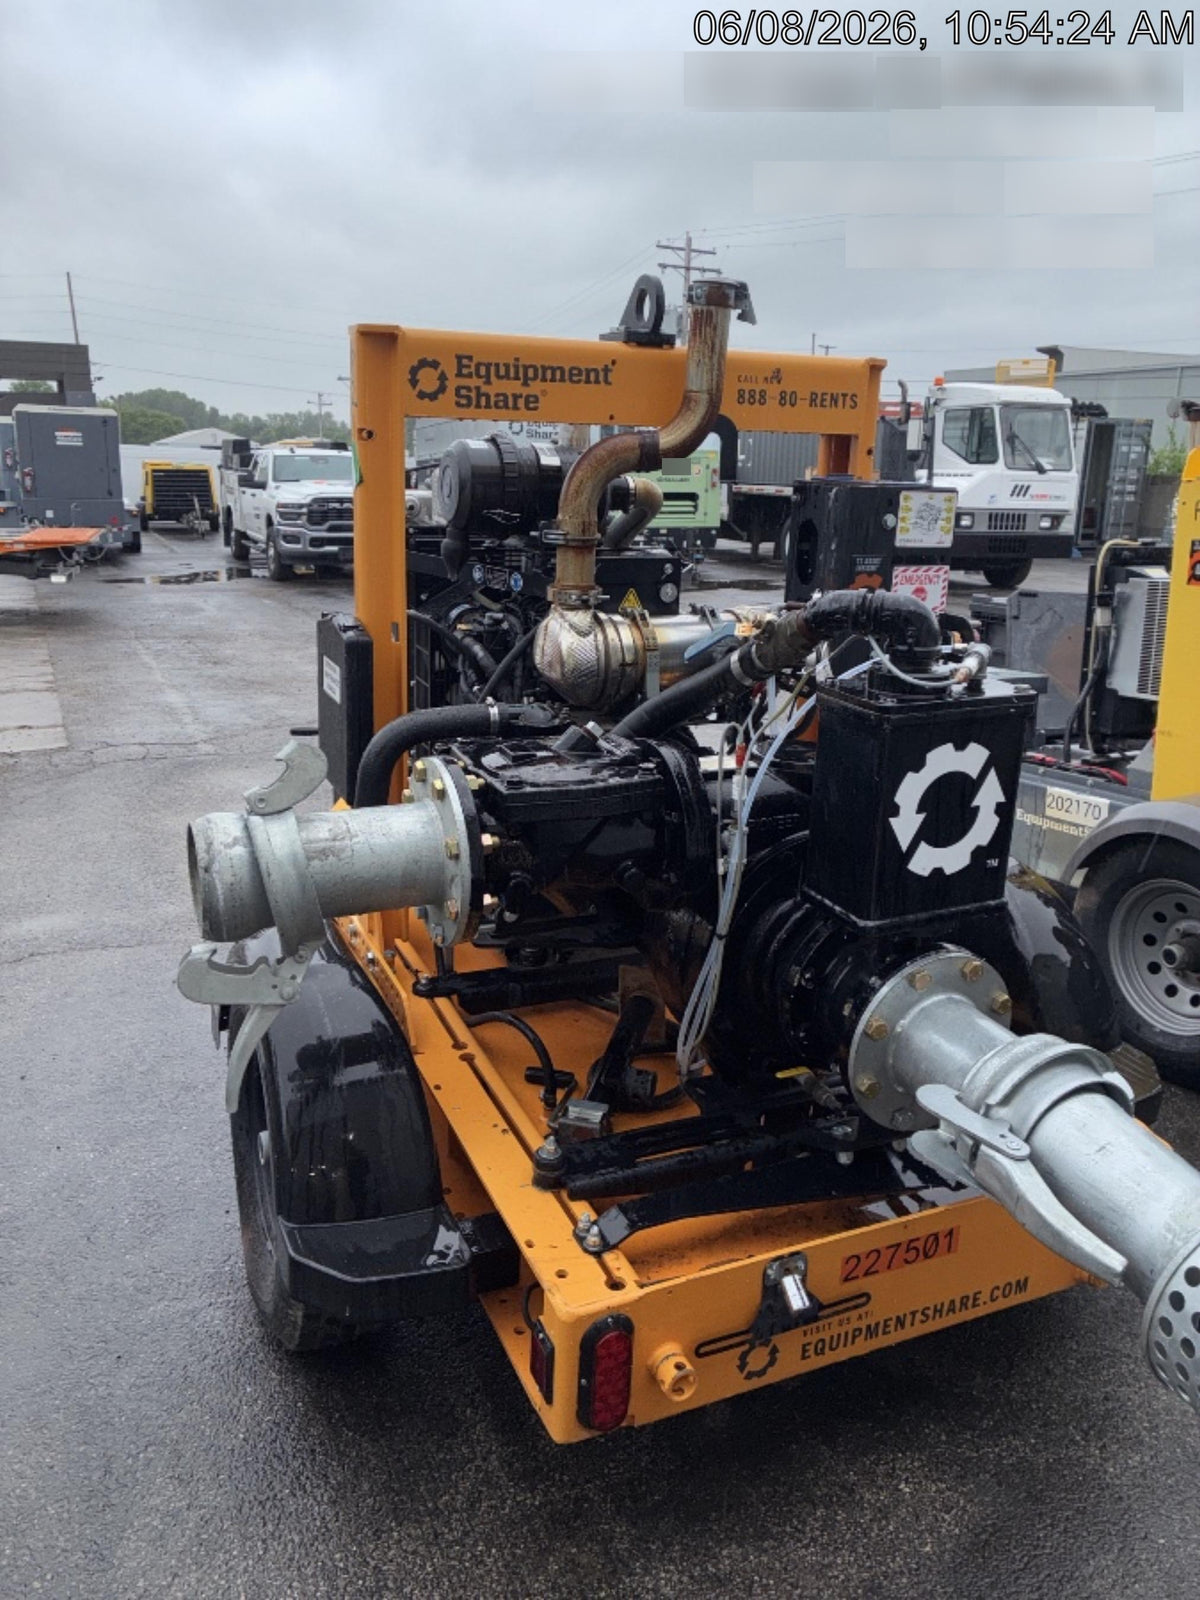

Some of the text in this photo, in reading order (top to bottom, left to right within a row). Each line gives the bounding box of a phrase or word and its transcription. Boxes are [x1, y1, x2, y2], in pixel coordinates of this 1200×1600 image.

[454, 354, 613, 387] Equipment
[1046, 793, 1102, 820] 202170
[842, 1227, 957, 1283] 227501
[800, 1276, 1030, 1361] EQUIPMENTSHARE.COM
[803, 1321, 833, 1337] VISIT
